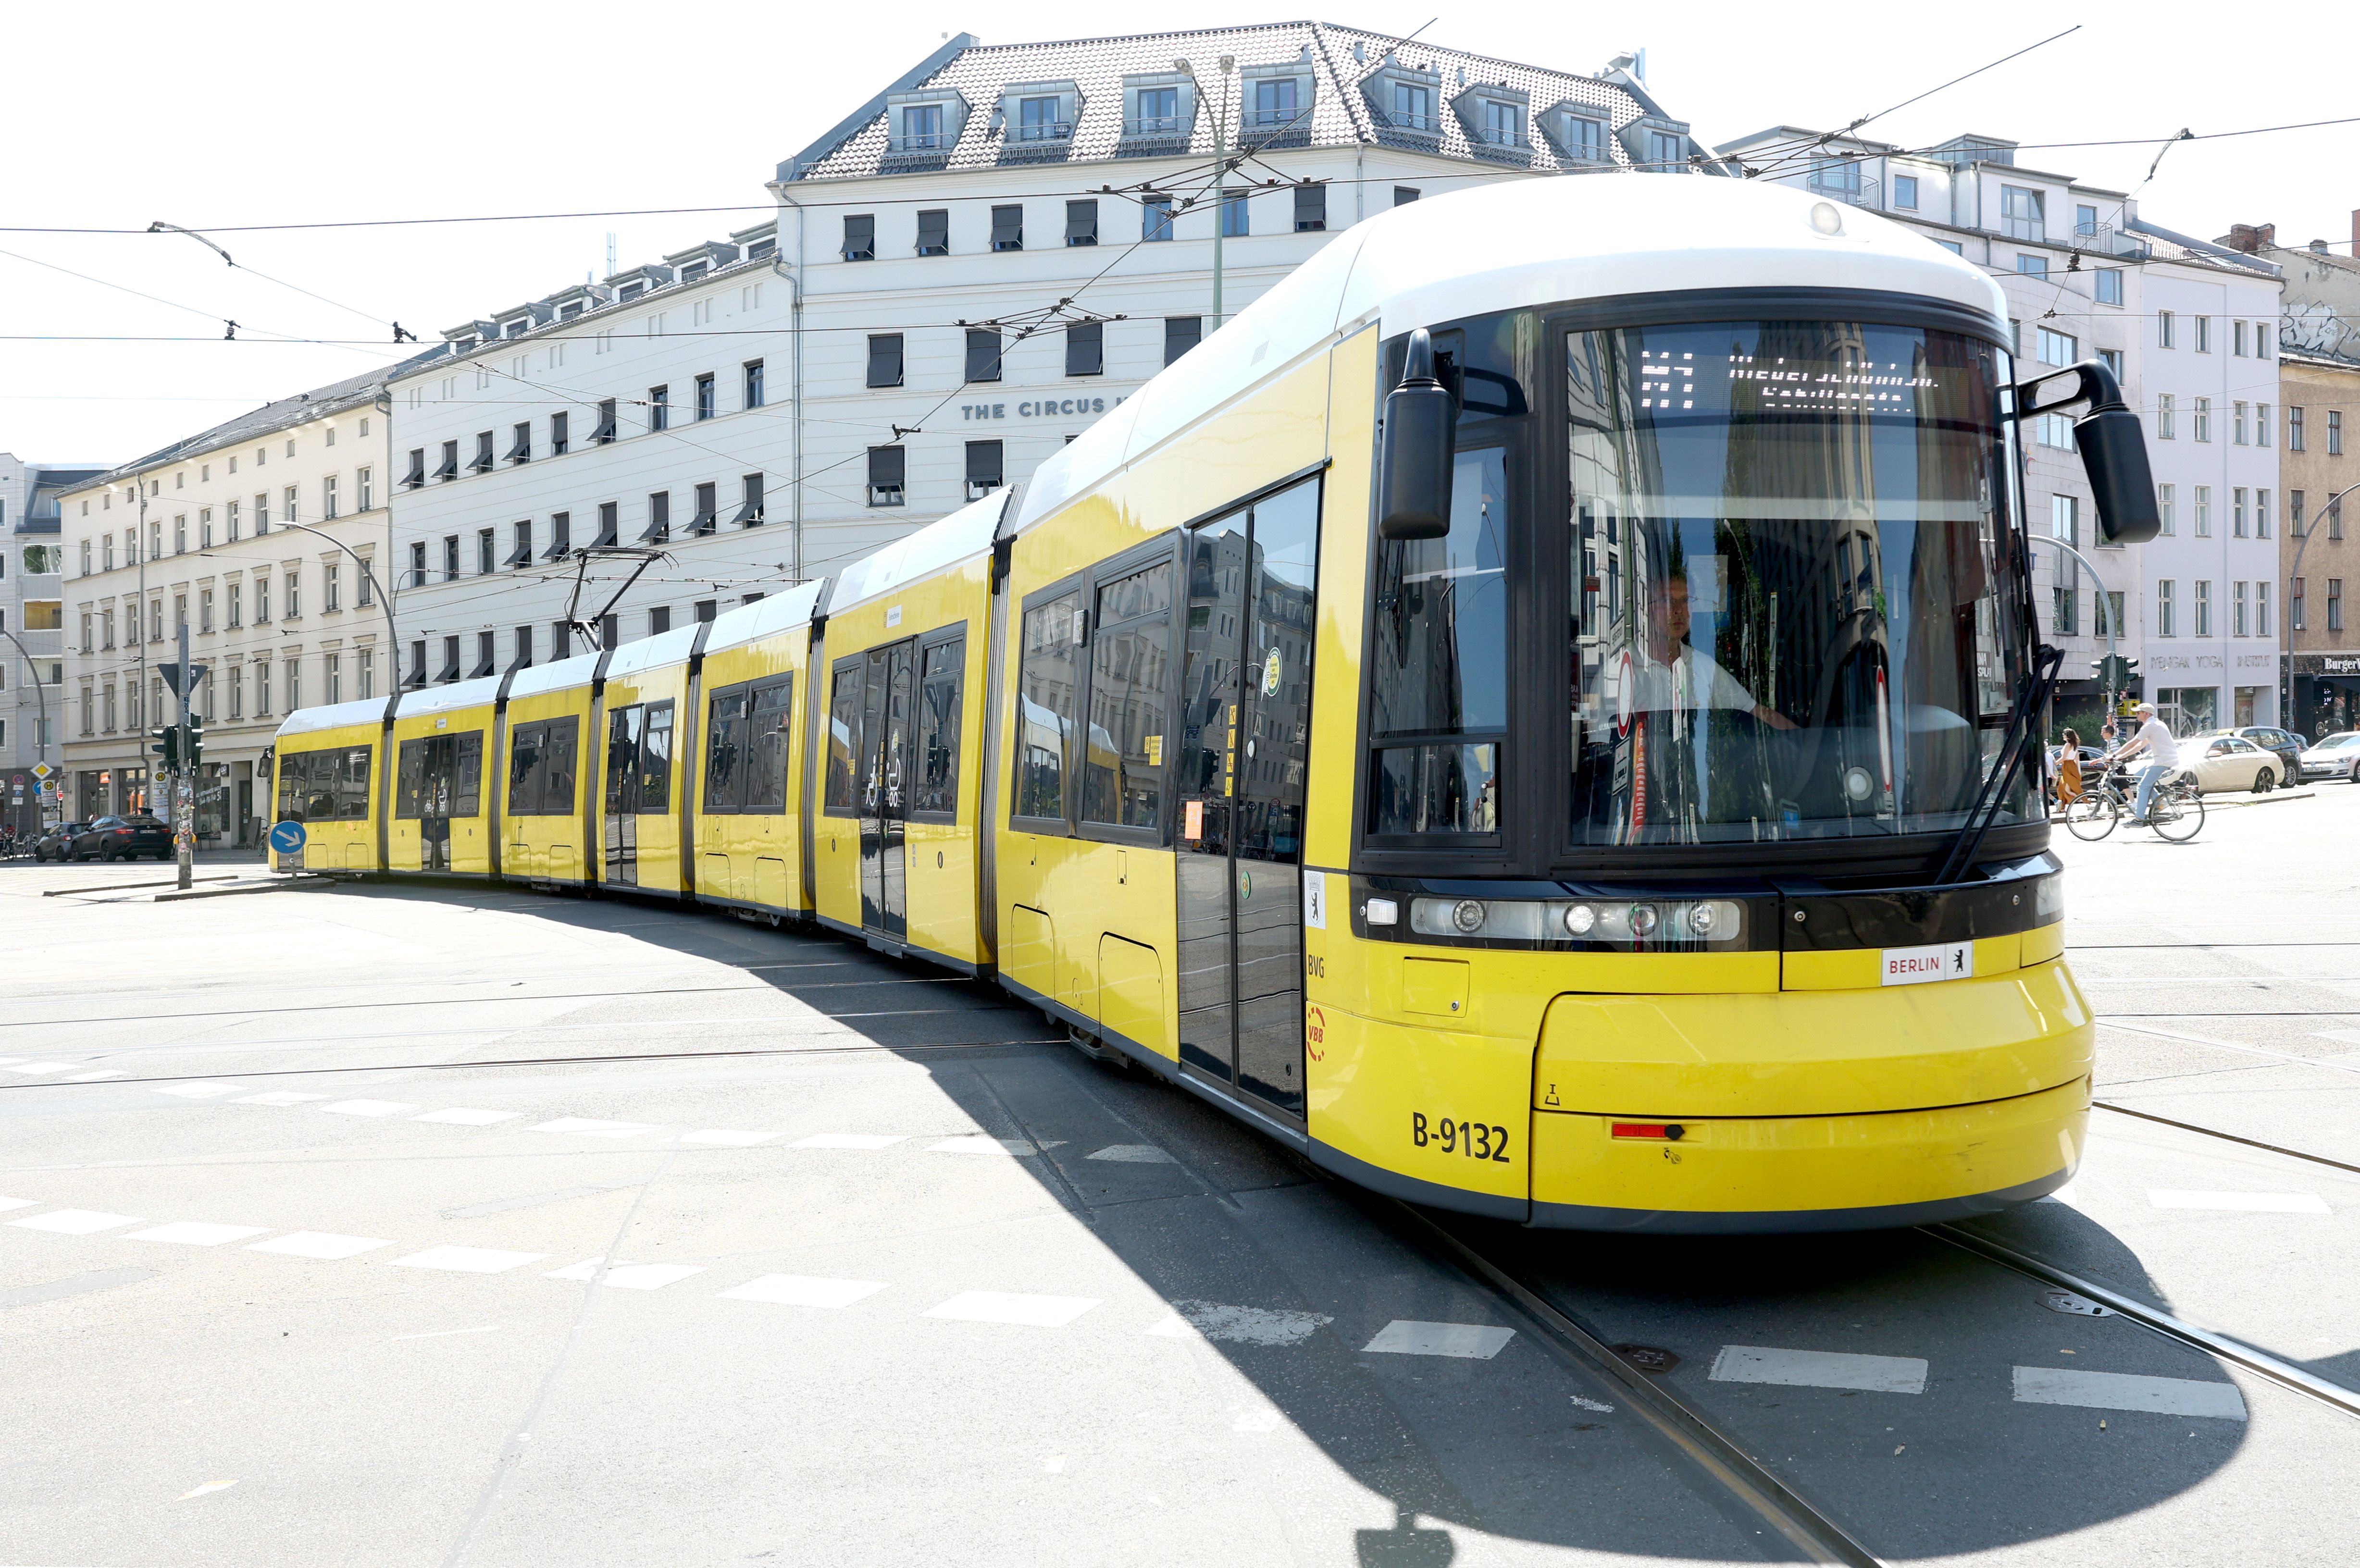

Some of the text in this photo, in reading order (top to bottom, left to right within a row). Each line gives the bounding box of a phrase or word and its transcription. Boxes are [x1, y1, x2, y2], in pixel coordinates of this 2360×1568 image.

[961, 404, 1005, 420] THE
[1019, 397, 1105, 417] CIRCUS
[2196, 655, 2223, 668] YOGA
[2237, 654, 2271, 667] INSTITUT
[1308, 954, 1325, 979] BVG
[1890, 957, 1939, 974] BERLIN
[1308, 1025, 1324, 1043] VBB
[1413, 1111, 1510, 1163] B-9132
